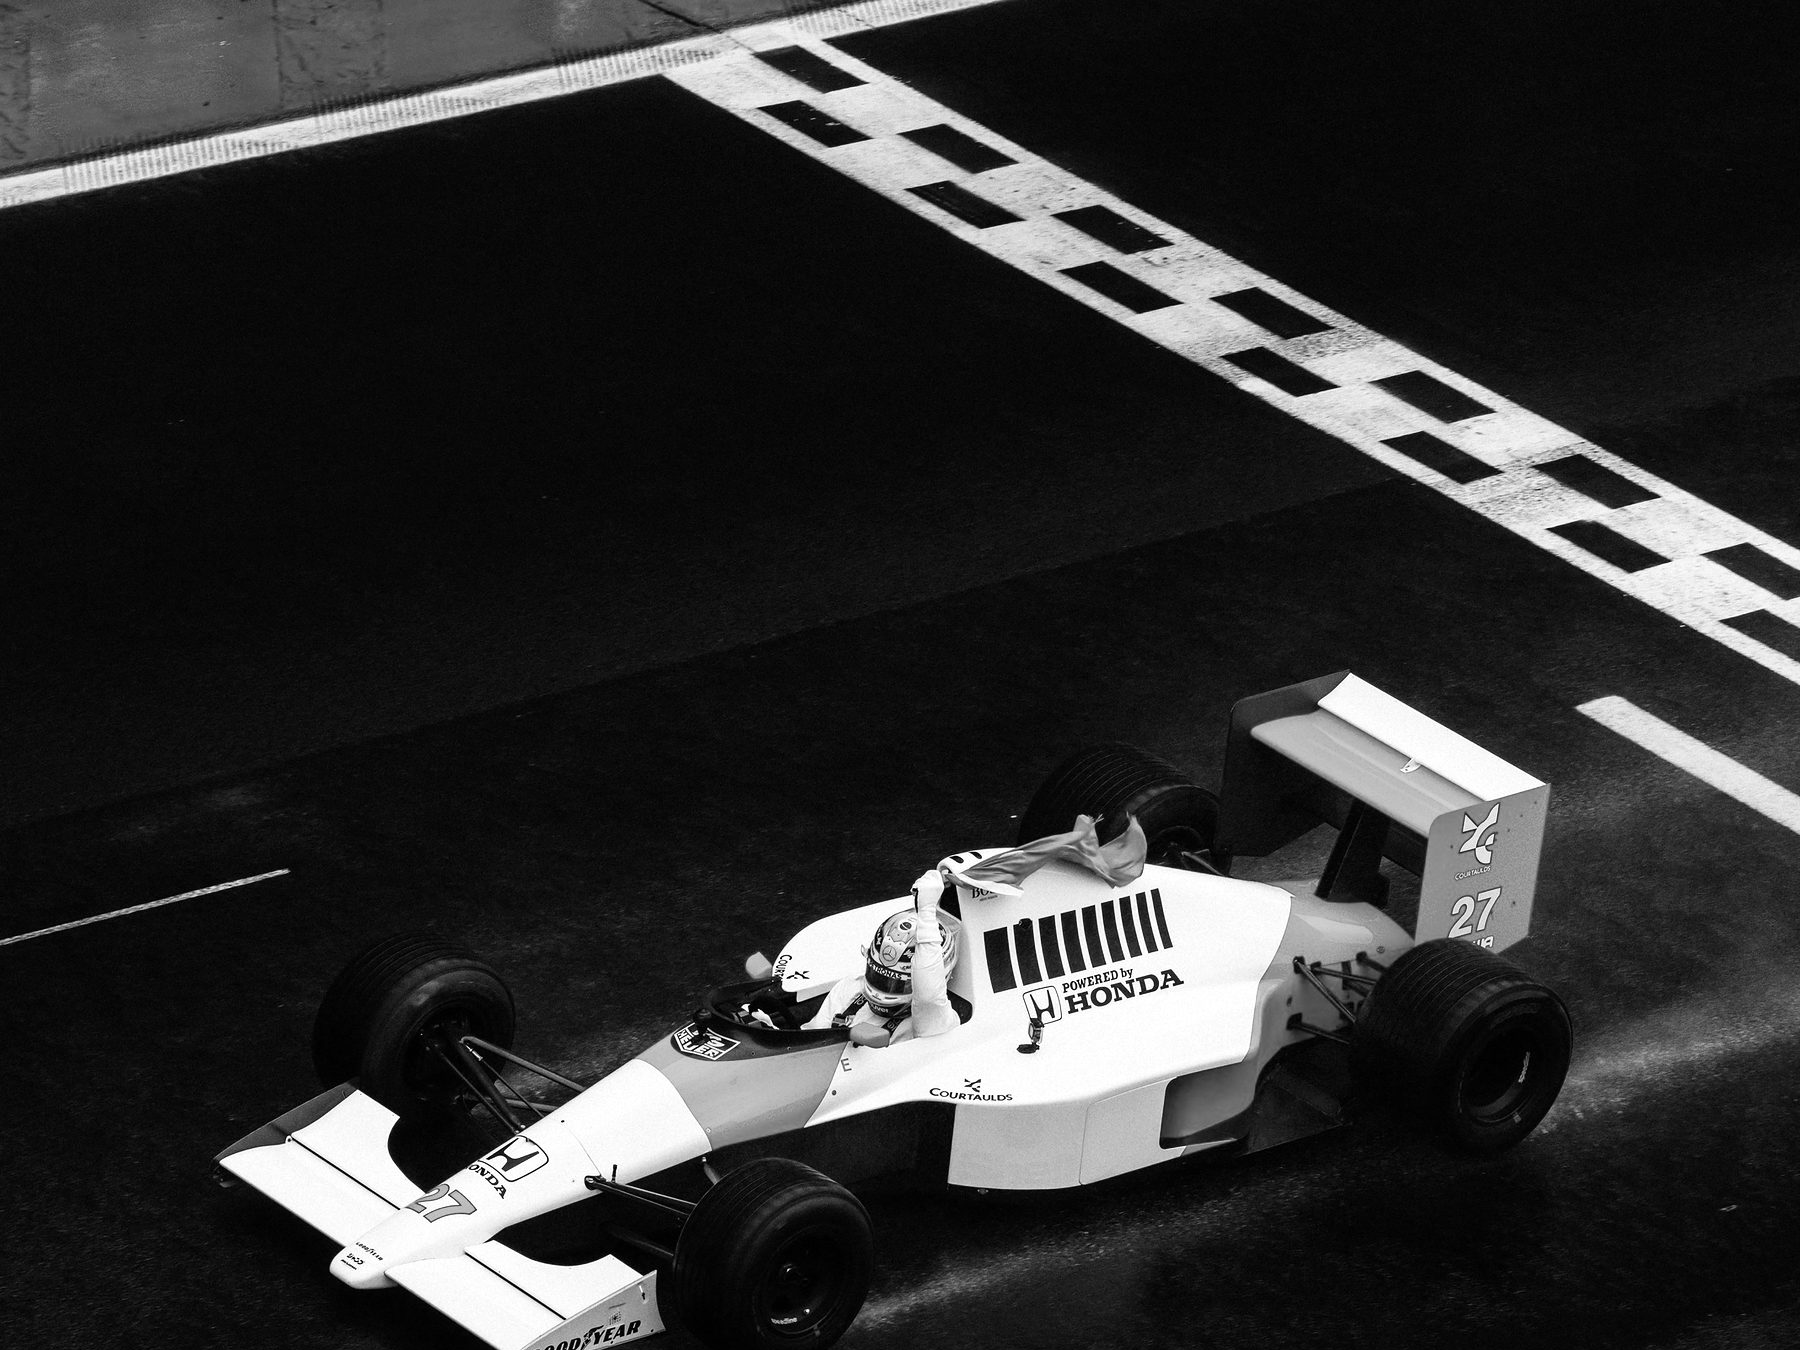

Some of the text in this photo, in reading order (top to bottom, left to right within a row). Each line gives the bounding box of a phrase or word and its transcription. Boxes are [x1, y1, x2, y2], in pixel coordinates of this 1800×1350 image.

[1447, 886, 1503, 939] 27
[774, 954, 793, 979] COURT
[1061, 966, 1133, 994] POWERED by
[1064, 968, 1184, 1015] HONDA
[929, 1087, 1013, 1102] COURTAULDS
[467, 1163, 507, 1200] ONDA
[404, 1183, 478, 1224] 27
